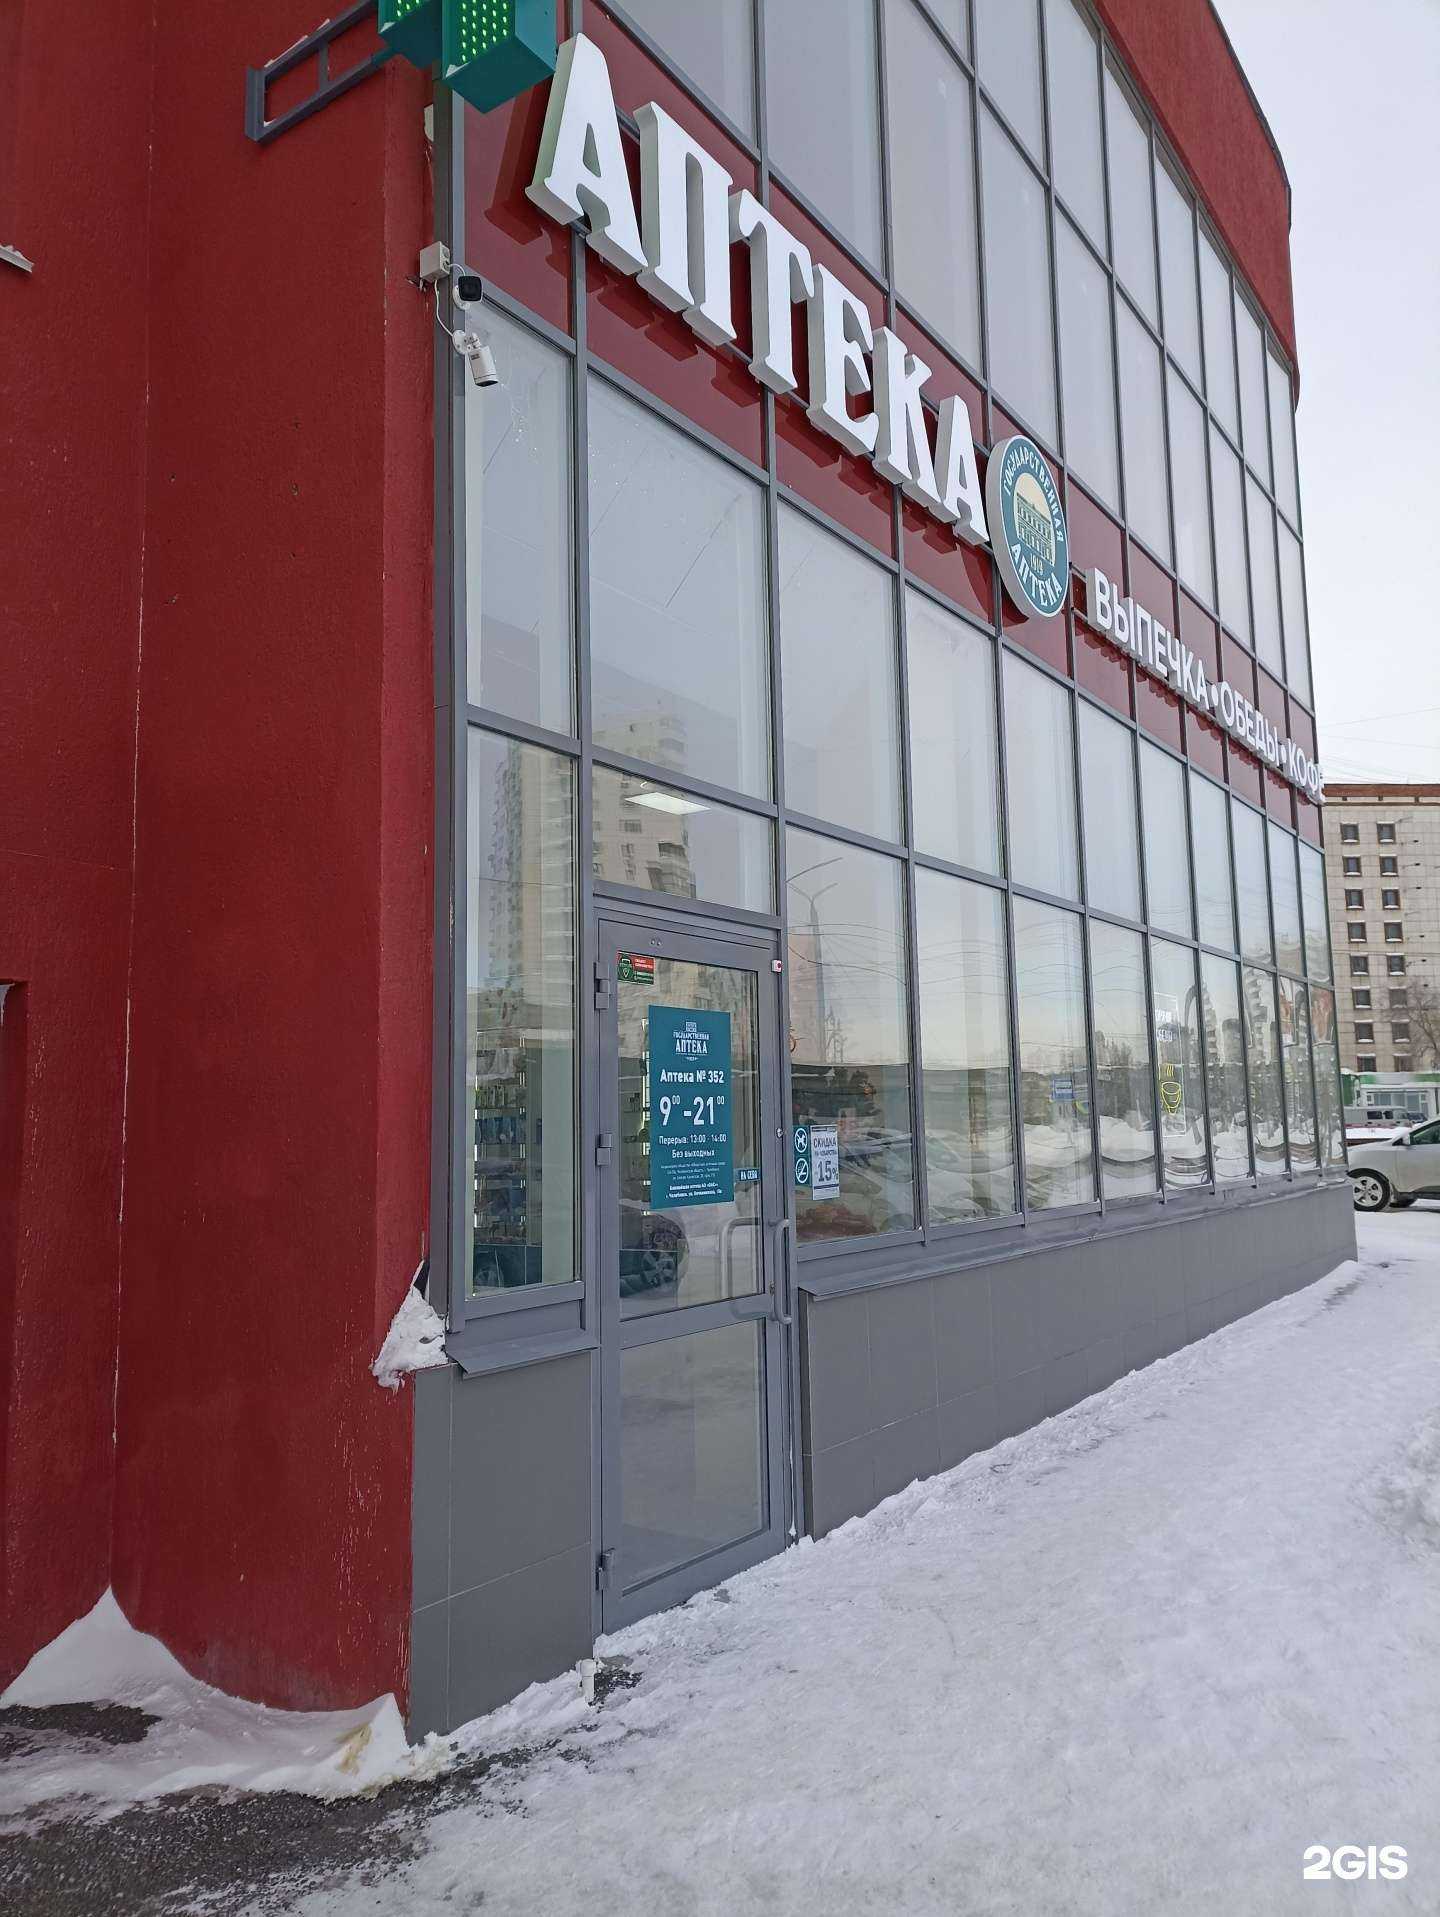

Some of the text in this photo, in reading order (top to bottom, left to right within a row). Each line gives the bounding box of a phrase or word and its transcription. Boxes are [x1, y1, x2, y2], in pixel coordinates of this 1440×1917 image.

[526, 32, 989, 545] АПТЕКА
[1003, 446, 1064, 543] ГОСУДАРСТВЕННАЯ
[1011, 543, 1063, 607] АПТЕКА
[1090, 567, 1210, 710] ВЫПЕЧКА
[1218, 680, 1280, 768] ОБЕДЫ
[675, 1039, 708, 1054] АПТЕКА
[660, 1068, 694, 1083] Аптека
[708, 1070, 725, 1083] 352
[690, 1134, 706, 1144] 13:00
[813, 1137, 837, 1149] СКИДКА
[672, 1149, 715, 1158] Без выходных
